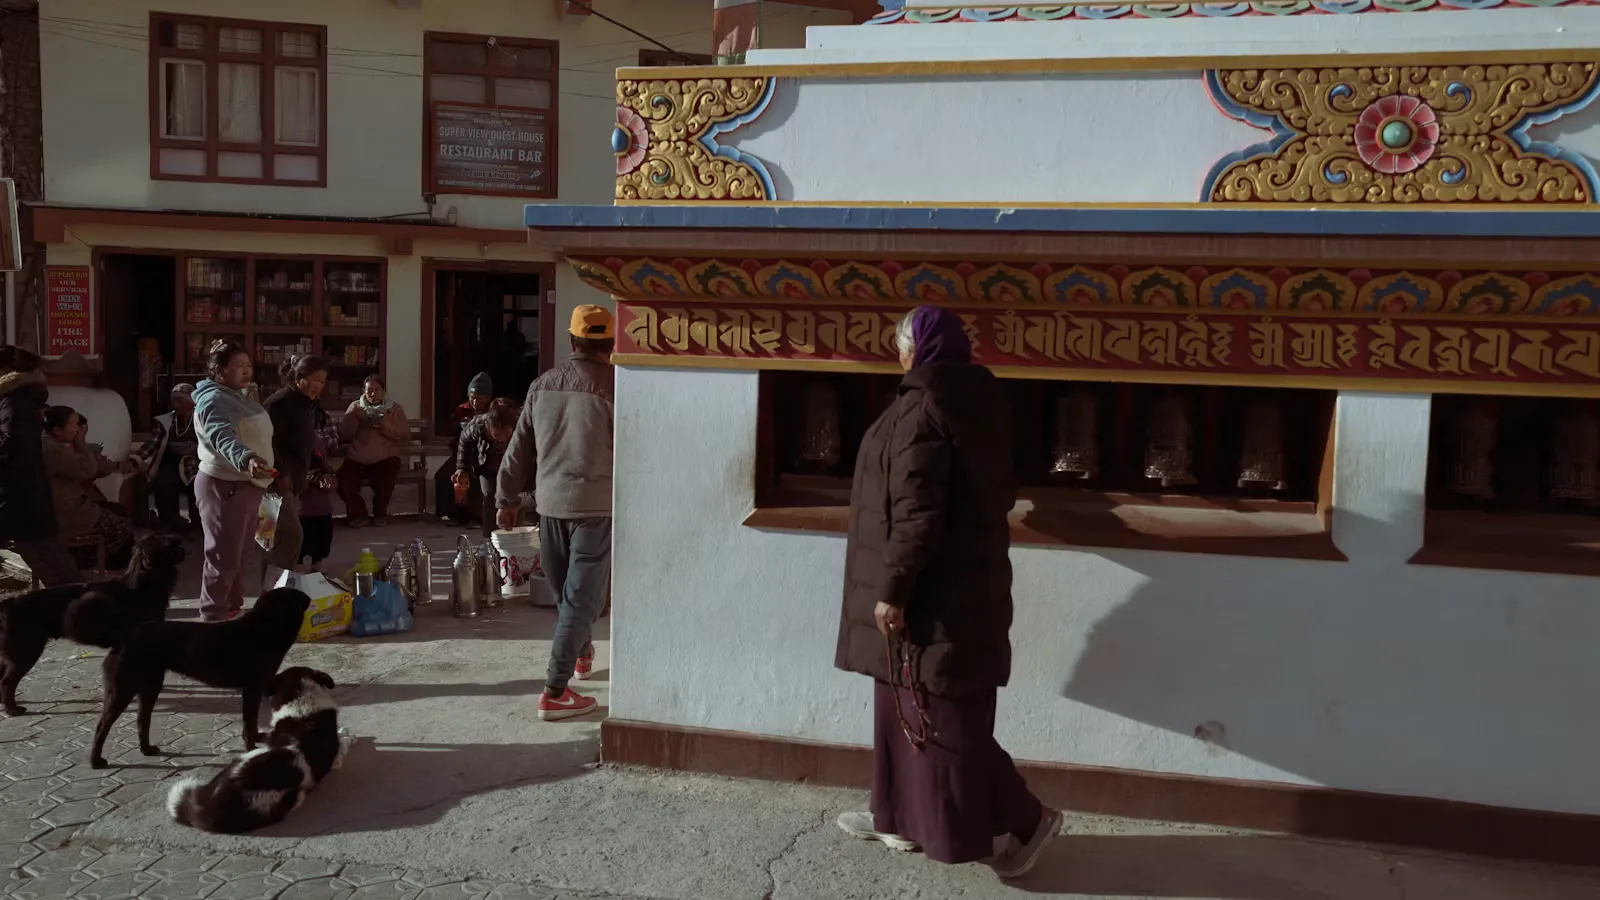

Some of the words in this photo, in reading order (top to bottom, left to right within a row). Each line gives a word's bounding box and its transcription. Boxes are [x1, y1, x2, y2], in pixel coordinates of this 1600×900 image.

[439, 126, 465, 138] SUPER
[468, 127, 489, 139] VIEW
[491, 129, 516, 141] GUEST
[518, 131, 544, 143] HOUSE
[439, 143, 514, 161] RESTAURANT
[518, 149, 542, 163] BAR
[57, 327, 84, 336] FIRE
[52, 338, 88, 347] PLACE
